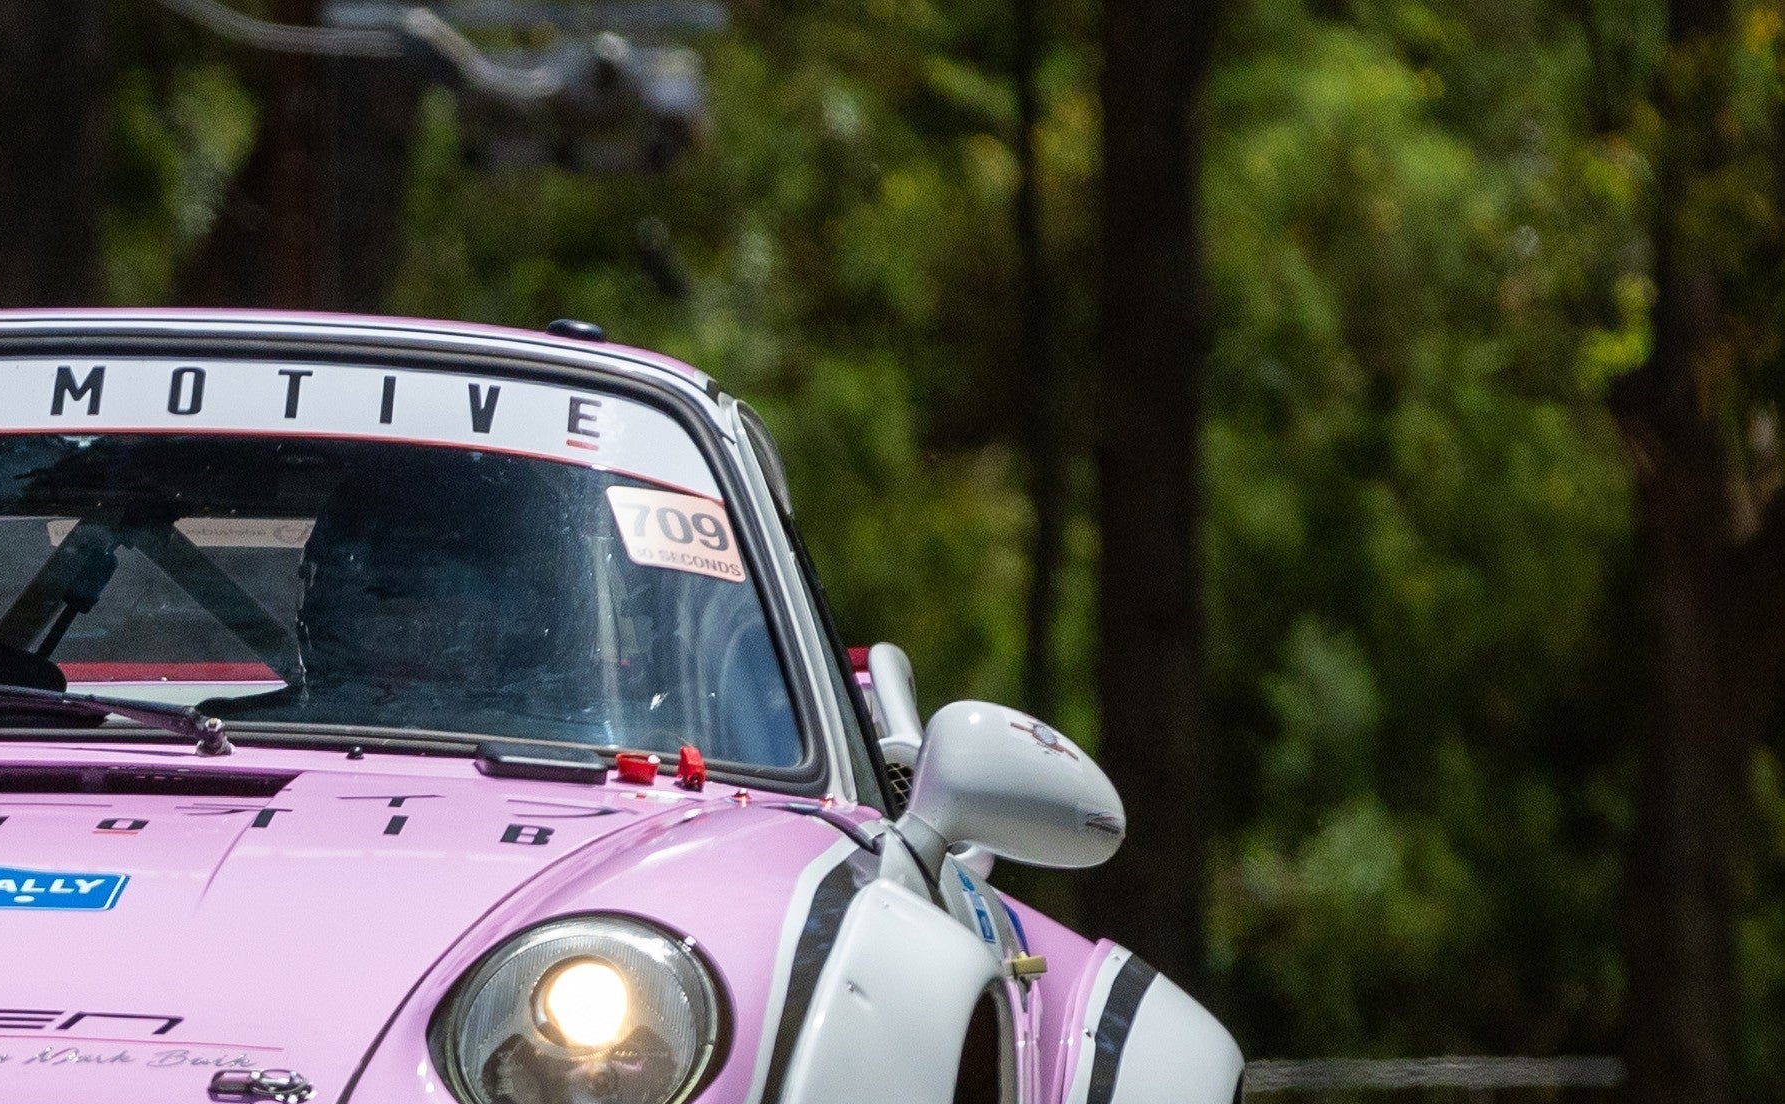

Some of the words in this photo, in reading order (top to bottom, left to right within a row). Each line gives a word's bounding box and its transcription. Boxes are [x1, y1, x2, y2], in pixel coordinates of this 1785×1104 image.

[619, 503, 729, 551] 709
[658, 549, 742, 577] SECONDS
[24, 1046, 138, 1065] Mark
